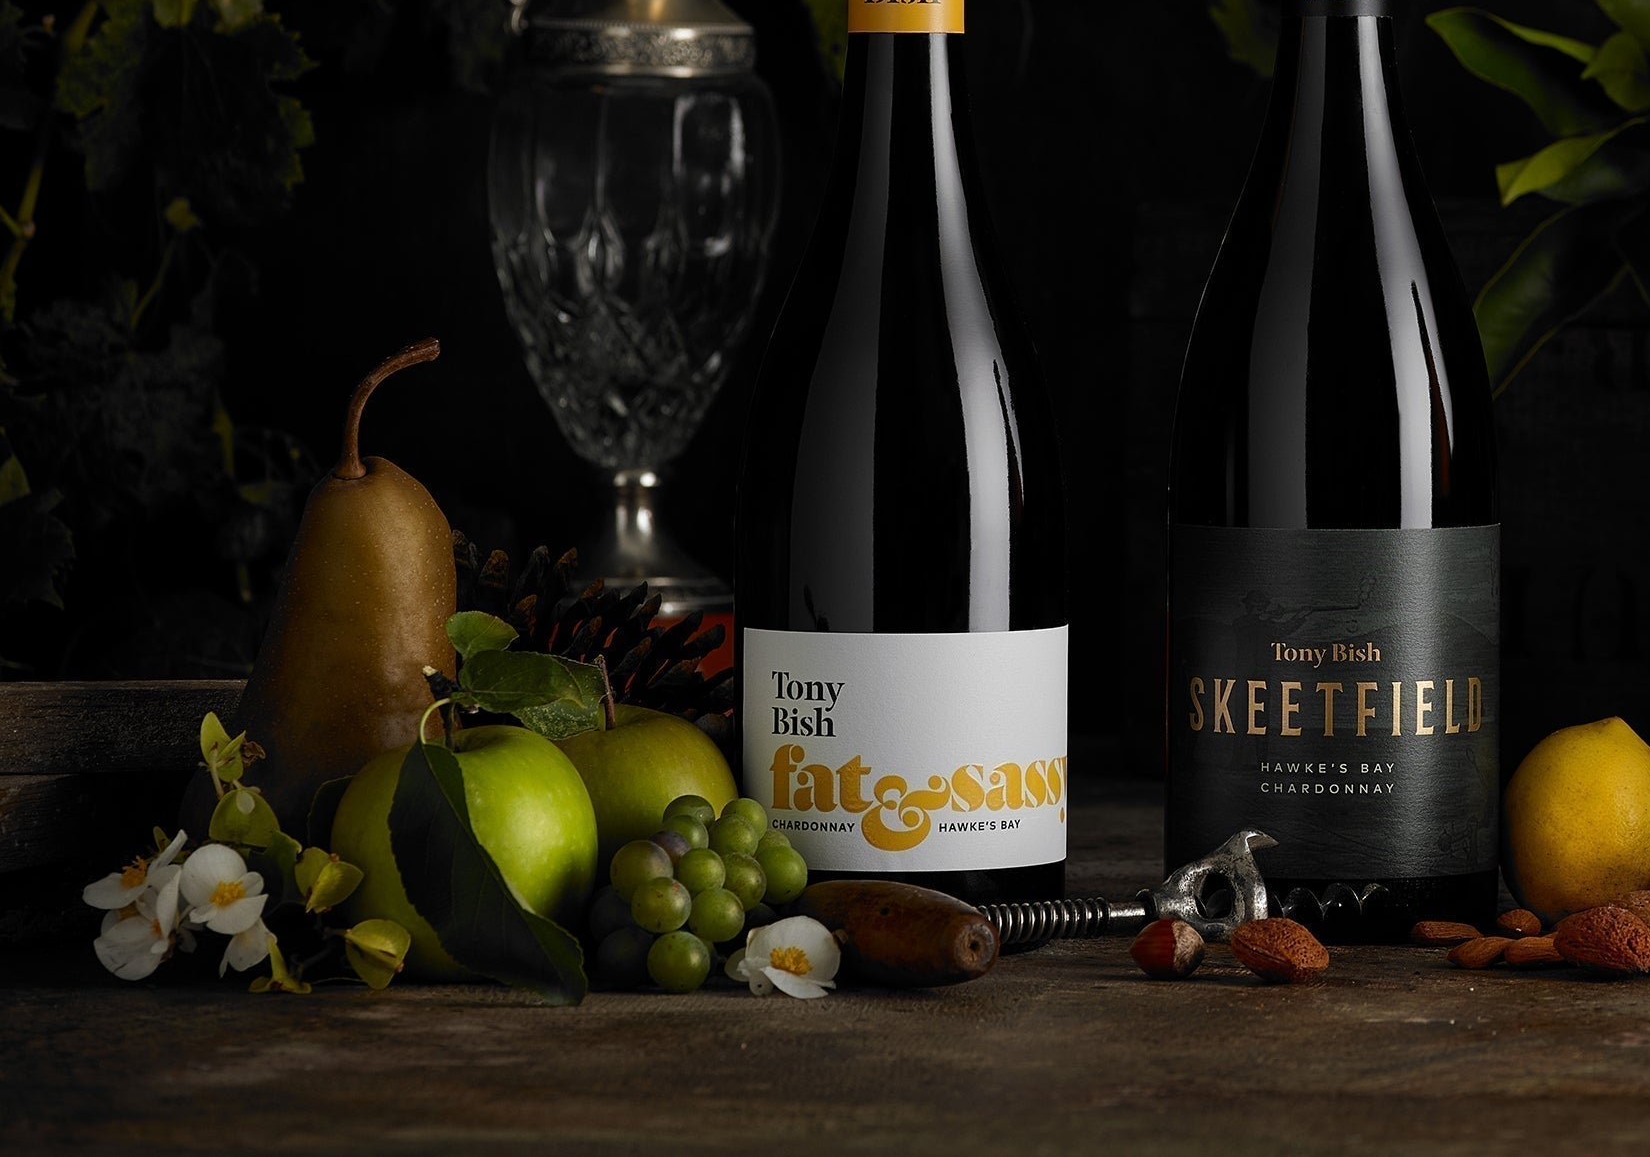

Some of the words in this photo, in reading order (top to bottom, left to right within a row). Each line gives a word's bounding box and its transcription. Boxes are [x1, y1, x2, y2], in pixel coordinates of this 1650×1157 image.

[1270, 641, 1327, 668] Tony
[1331, 642, 1381, 662] Bish
[771, 671, 845, 712] Tony
[1187, 675, 1484, 737] SKEETFIELD
[771, 706, 837, 738] Bish
[1260, 761, 1349, 774] HAWKE'S
[1360, 762, 1396, 774] BAY
[1260, 781, 1396, 794] CHARDONNAY
[772, 819, 856, 833] CHARDONNAY
[938, 820, 998, 833] HAWKE'S
[1000, 818, 1022, 831] BAY
